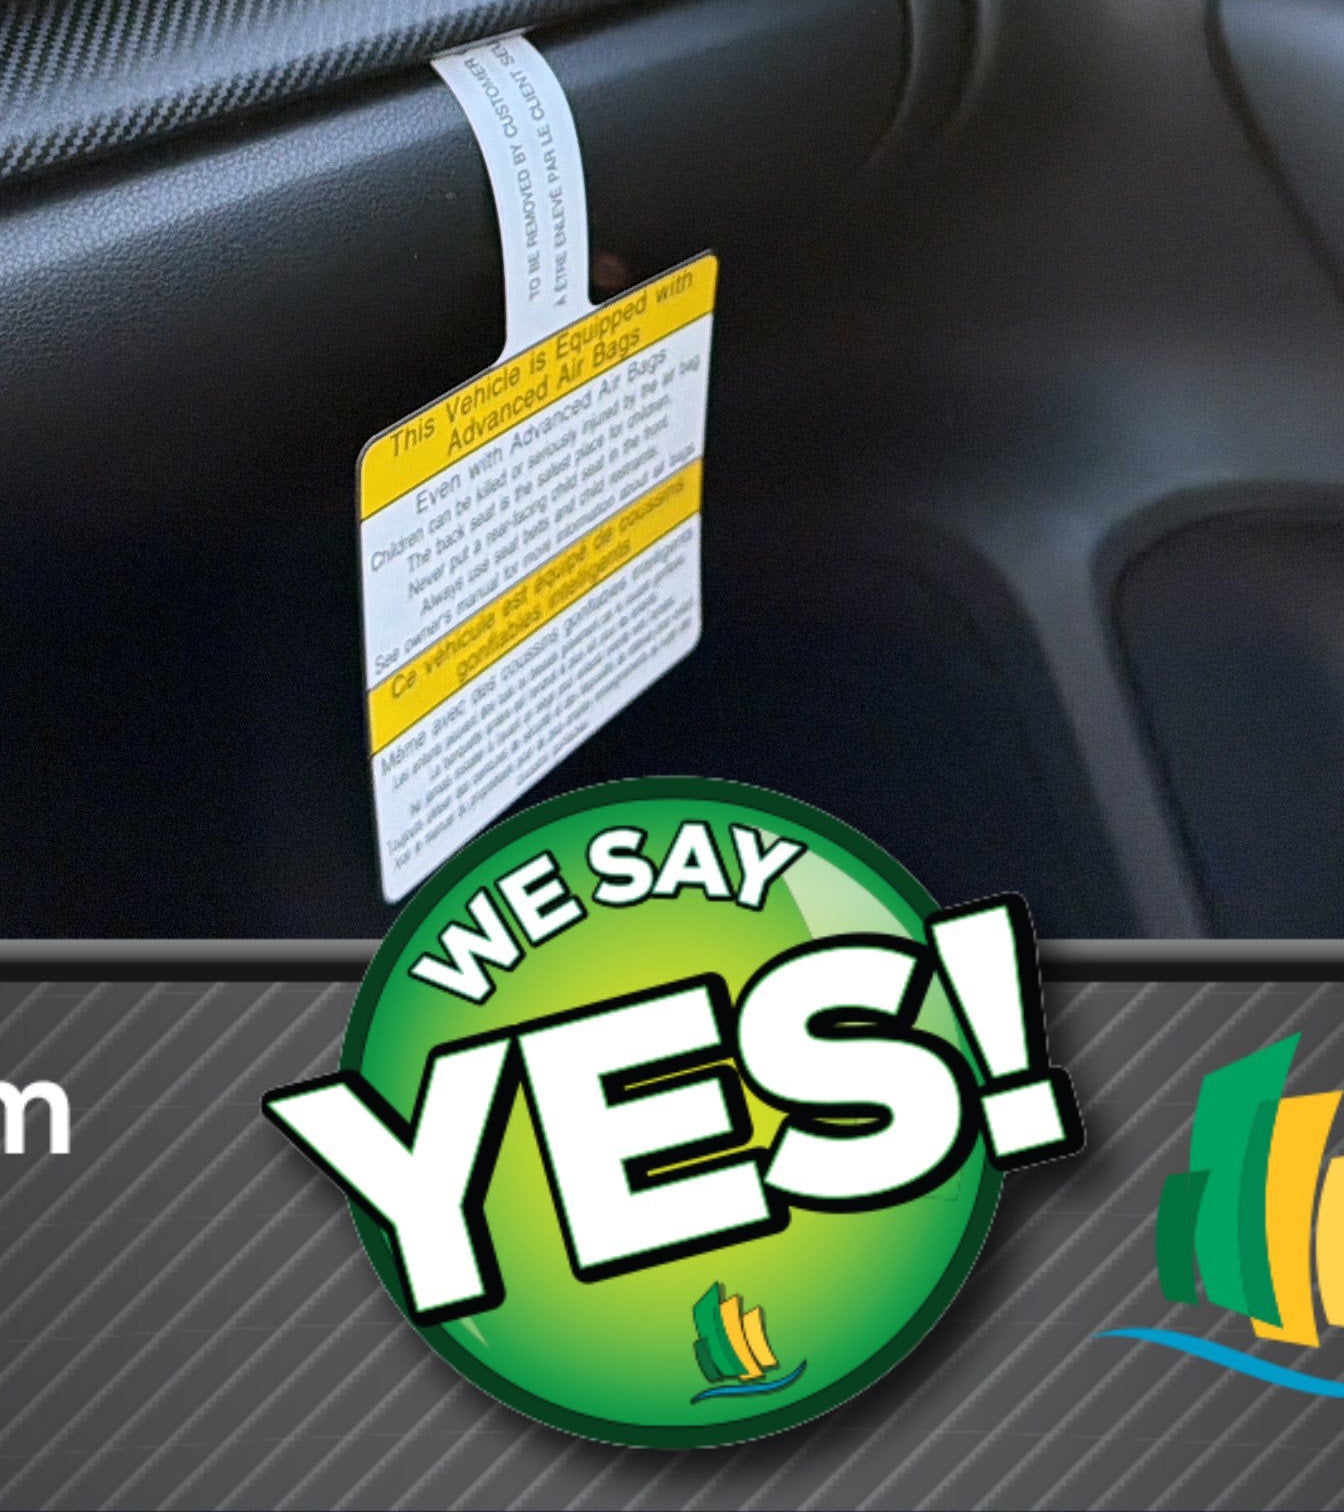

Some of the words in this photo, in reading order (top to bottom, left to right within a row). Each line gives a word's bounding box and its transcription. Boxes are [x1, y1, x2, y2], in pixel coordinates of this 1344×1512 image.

[463, 57, 518, 138] CUSTOMER
[510, 68, 545, 121] CLIENT
[509, 143, 525, 163] BY
[537, 124, 554, 145] LE
[543, 148, 561, 182] PAR
[517, 169, 539, 246] REMOVED
[528, 250, 541, 272] BE
[527, 277, 541, 300] TO
[390, 415, 435, 457] This
[446, 365, 520, 424] Vehicle
[529, 350, 546, 375] is
[556, 288, 647, 362] Equipped
[655, 270, 693, 304] with
[447, 373, 549, 454] Advanced
[557, 356, 584, 389] Air
[592, 326, 640, 369] Bags
[414, 472, 461, 515] Even
[468, 446, 503, 480] with
[509, 388, 591, 455] Advanced
[598, 373, 620, 399] Air
[626, 347, 667, 384] Bags
[390, 668, 416, 700] Ce
